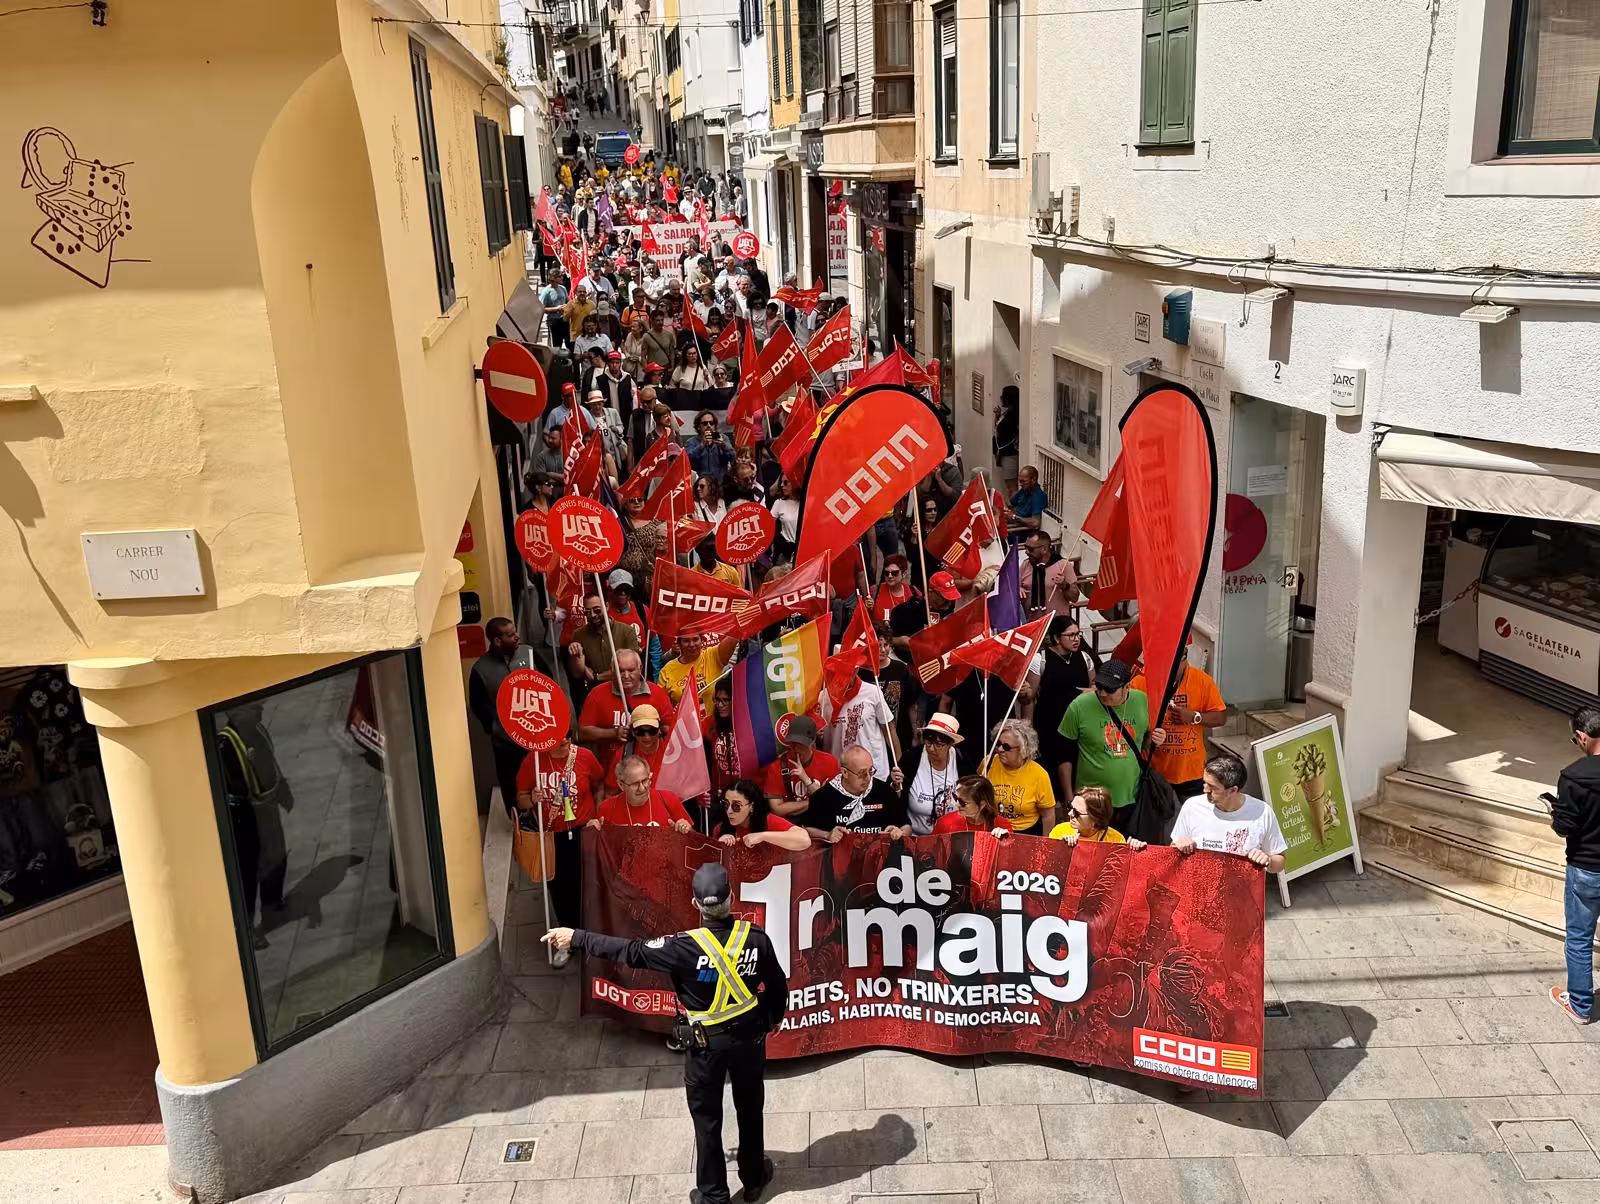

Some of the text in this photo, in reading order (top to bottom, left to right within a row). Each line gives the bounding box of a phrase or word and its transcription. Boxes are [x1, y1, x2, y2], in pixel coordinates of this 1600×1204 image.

[1274, 361, 1281, 380] 2
[1332, 373, 1356, 386] JARC
[555, 499, 603, 515] SERVEIS PÚBLICS
[524, 523, 550, 545] UGT
[562, 514, 603, 539] UGT
[727, 515, 761, 542] UGT
[116, 546, 164, 558] CARRER
[129, 568, 159, 582] NOU
[567, 555, 613, 573] ILLES BALEARS
[658, 588, 728, 613] CCOO
[508, 673, 555, 692] SERVEIS PÚBLICS
[511, 687, 552, 716] UGT
[511, 730, 557, 750] ILLES BALEARS
[836, 815, 849, 824] No
[1281, 803, 1301, 819] Gelat
[740, 855, 1061, 979] 1r de 2026
[846, 893, 1089, 1003] maig
[594, 980, 631, 1006] UGT
[787, 977, 1040, 1011] RETS, NO TRINXERES.
[779, 1003, 1041, 1032] ALARIS, HABITATGE I DEMOCRÀCIA
[1139, 1034, 1217, 1067] CCOO
[1172, 1065, 1201, 1081] obrera
[1202, 1071, 1214, 1083] de
[1216, 1074, 1258, 1090] Menorca
